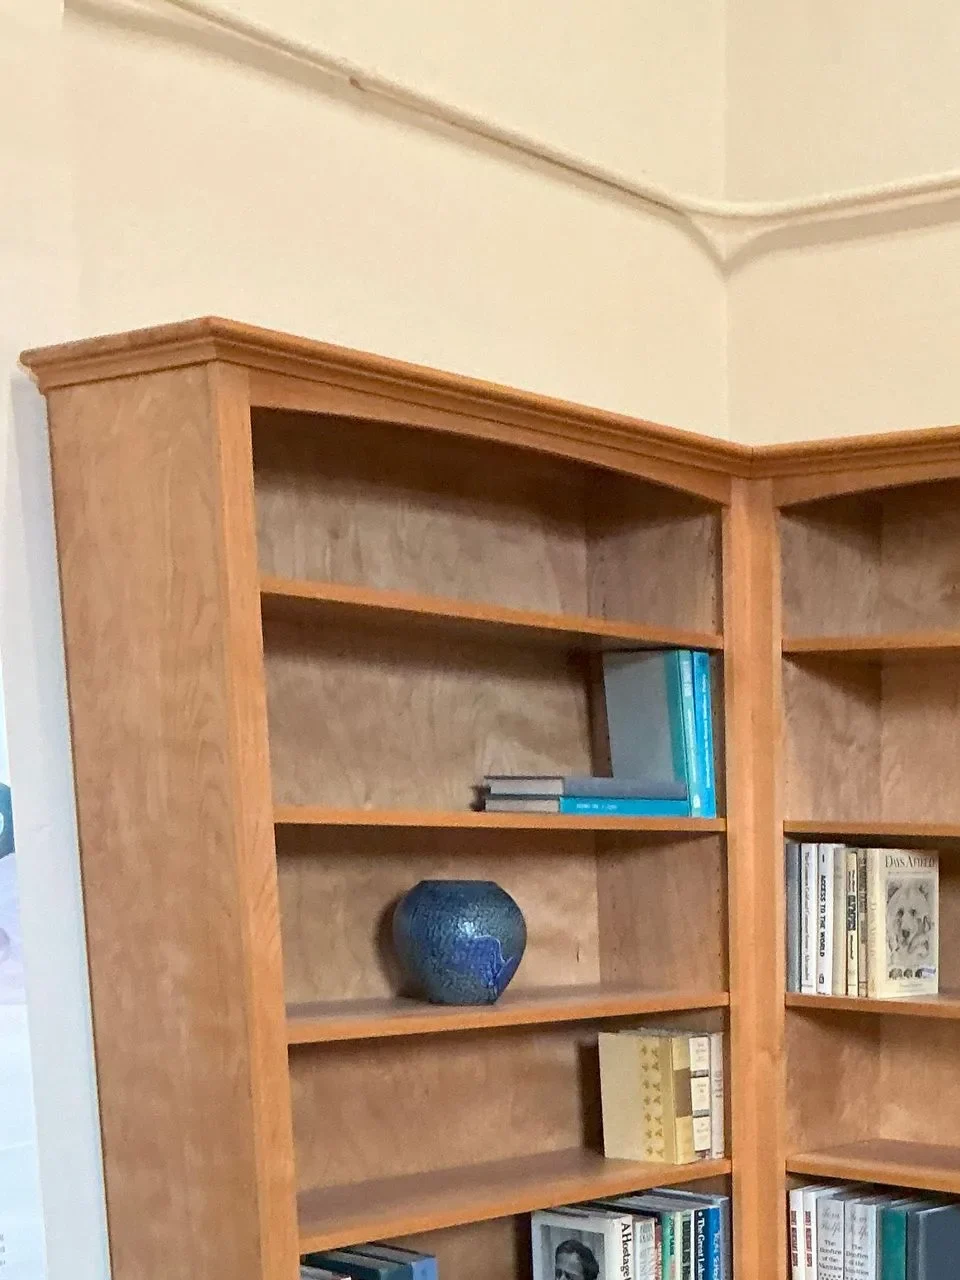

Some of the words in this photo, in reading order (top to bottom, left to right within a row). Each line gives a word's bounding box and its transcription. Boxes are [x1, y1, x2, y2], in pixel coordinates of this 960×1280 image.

[820, 904, 826, 914] TO
[621, 1222, 631, 1233] A
[697, 1218, 705, 1234] The
[697, 1234, 705, 1257] Great
[620, 1233, 633, 1277] Hostage
